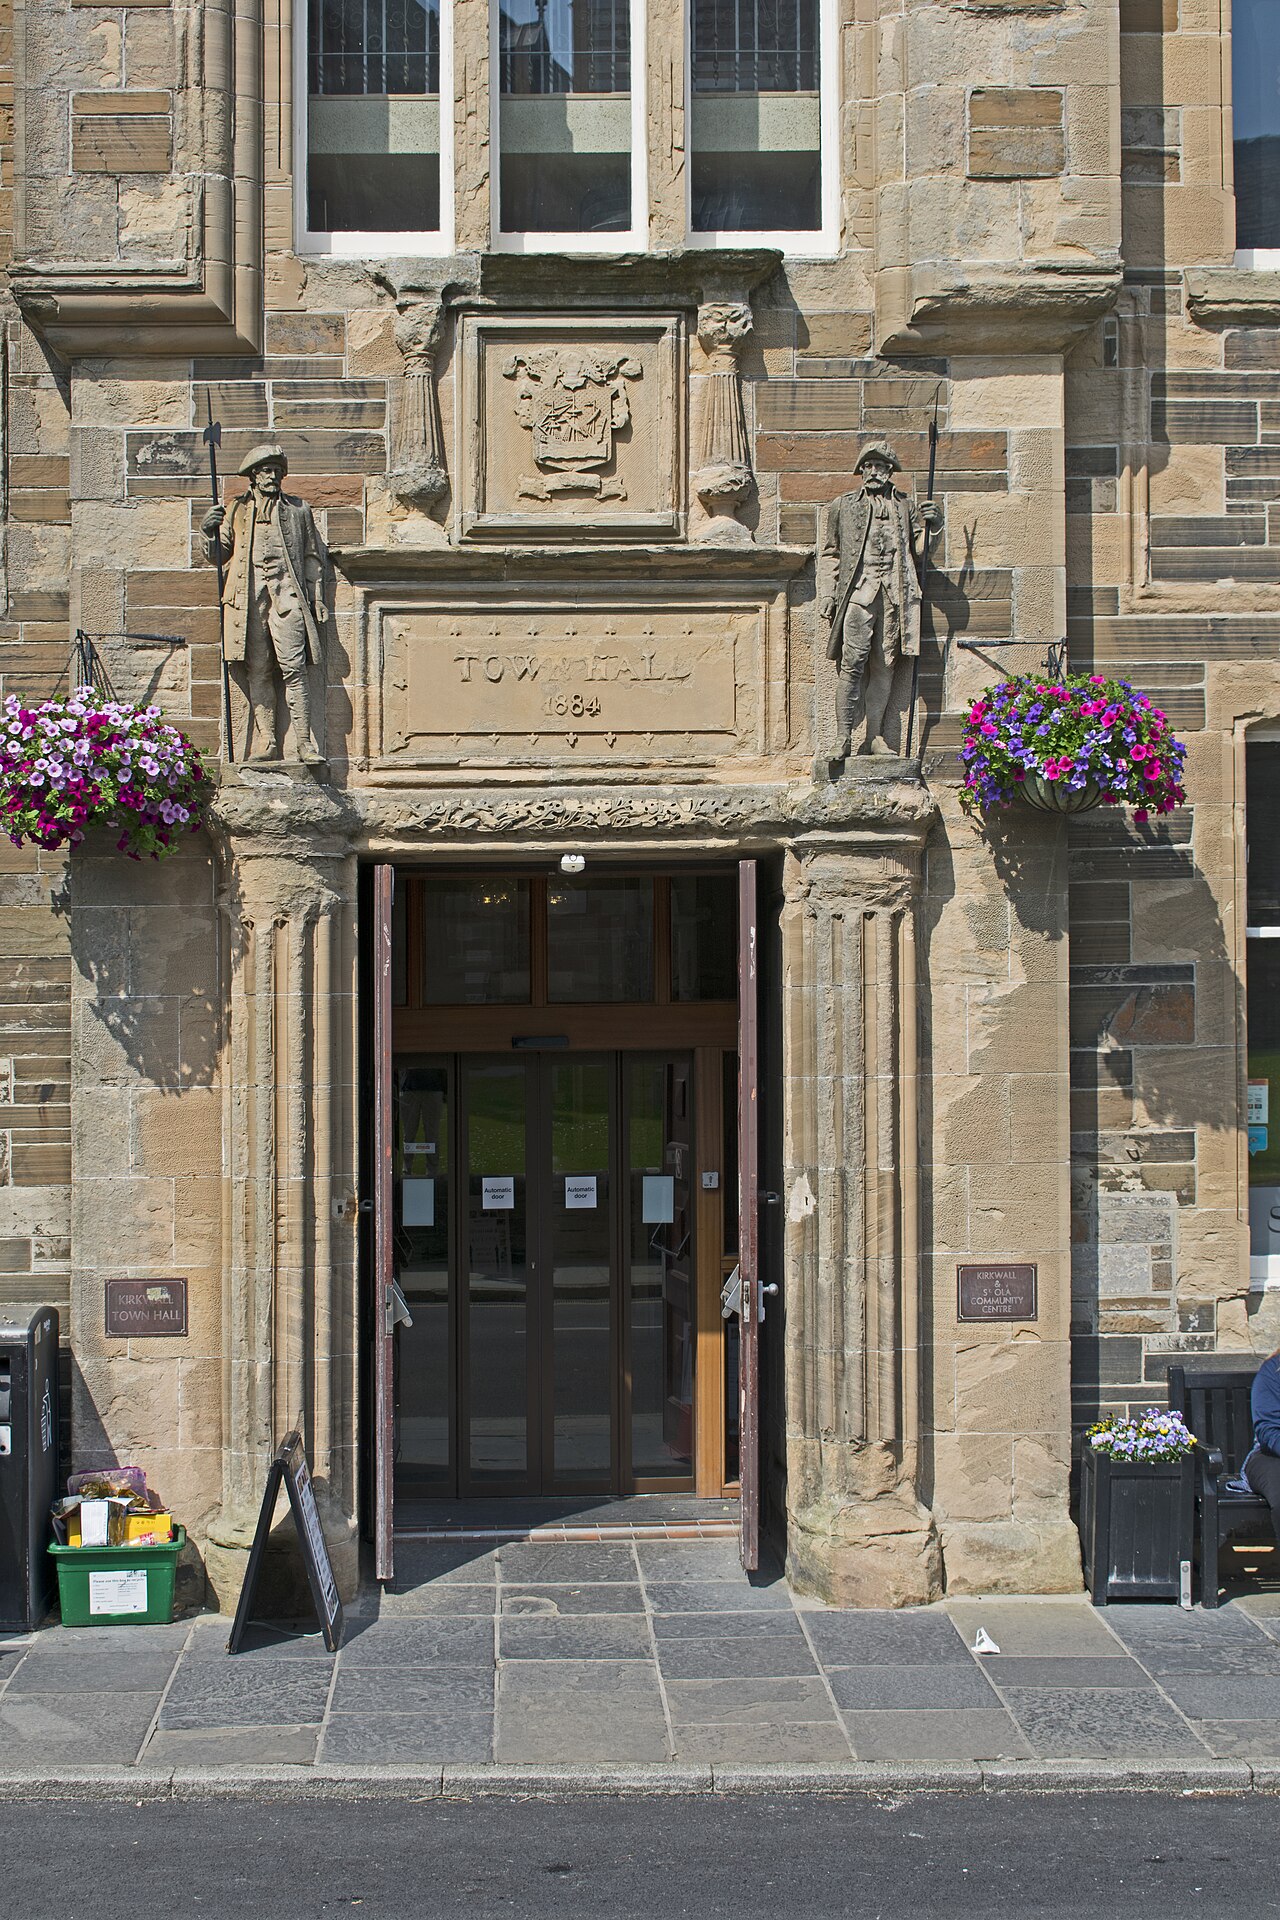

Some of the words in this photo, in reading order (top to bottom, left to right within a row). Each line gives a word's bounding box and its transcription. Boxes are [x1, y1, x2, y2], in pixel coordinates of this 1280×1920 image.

[453, 655, 583, 683] TOWN
[584, 650, 694, 683] HALL
[541, 693, 601, 717] 1884
[977, 1272, 1016, 1280] KIRKWALL
[994, 1280, 1001, 1288] &
[994, 1288, 1011, 1296] OLA
[971, 1297, 1024, 1305] COMMUNITY
[982, 1305, 1012, 1314] CENTRE
[111, 1310, 150, 1321] TOWN
[153, 1310, 181, 1321] HALL
